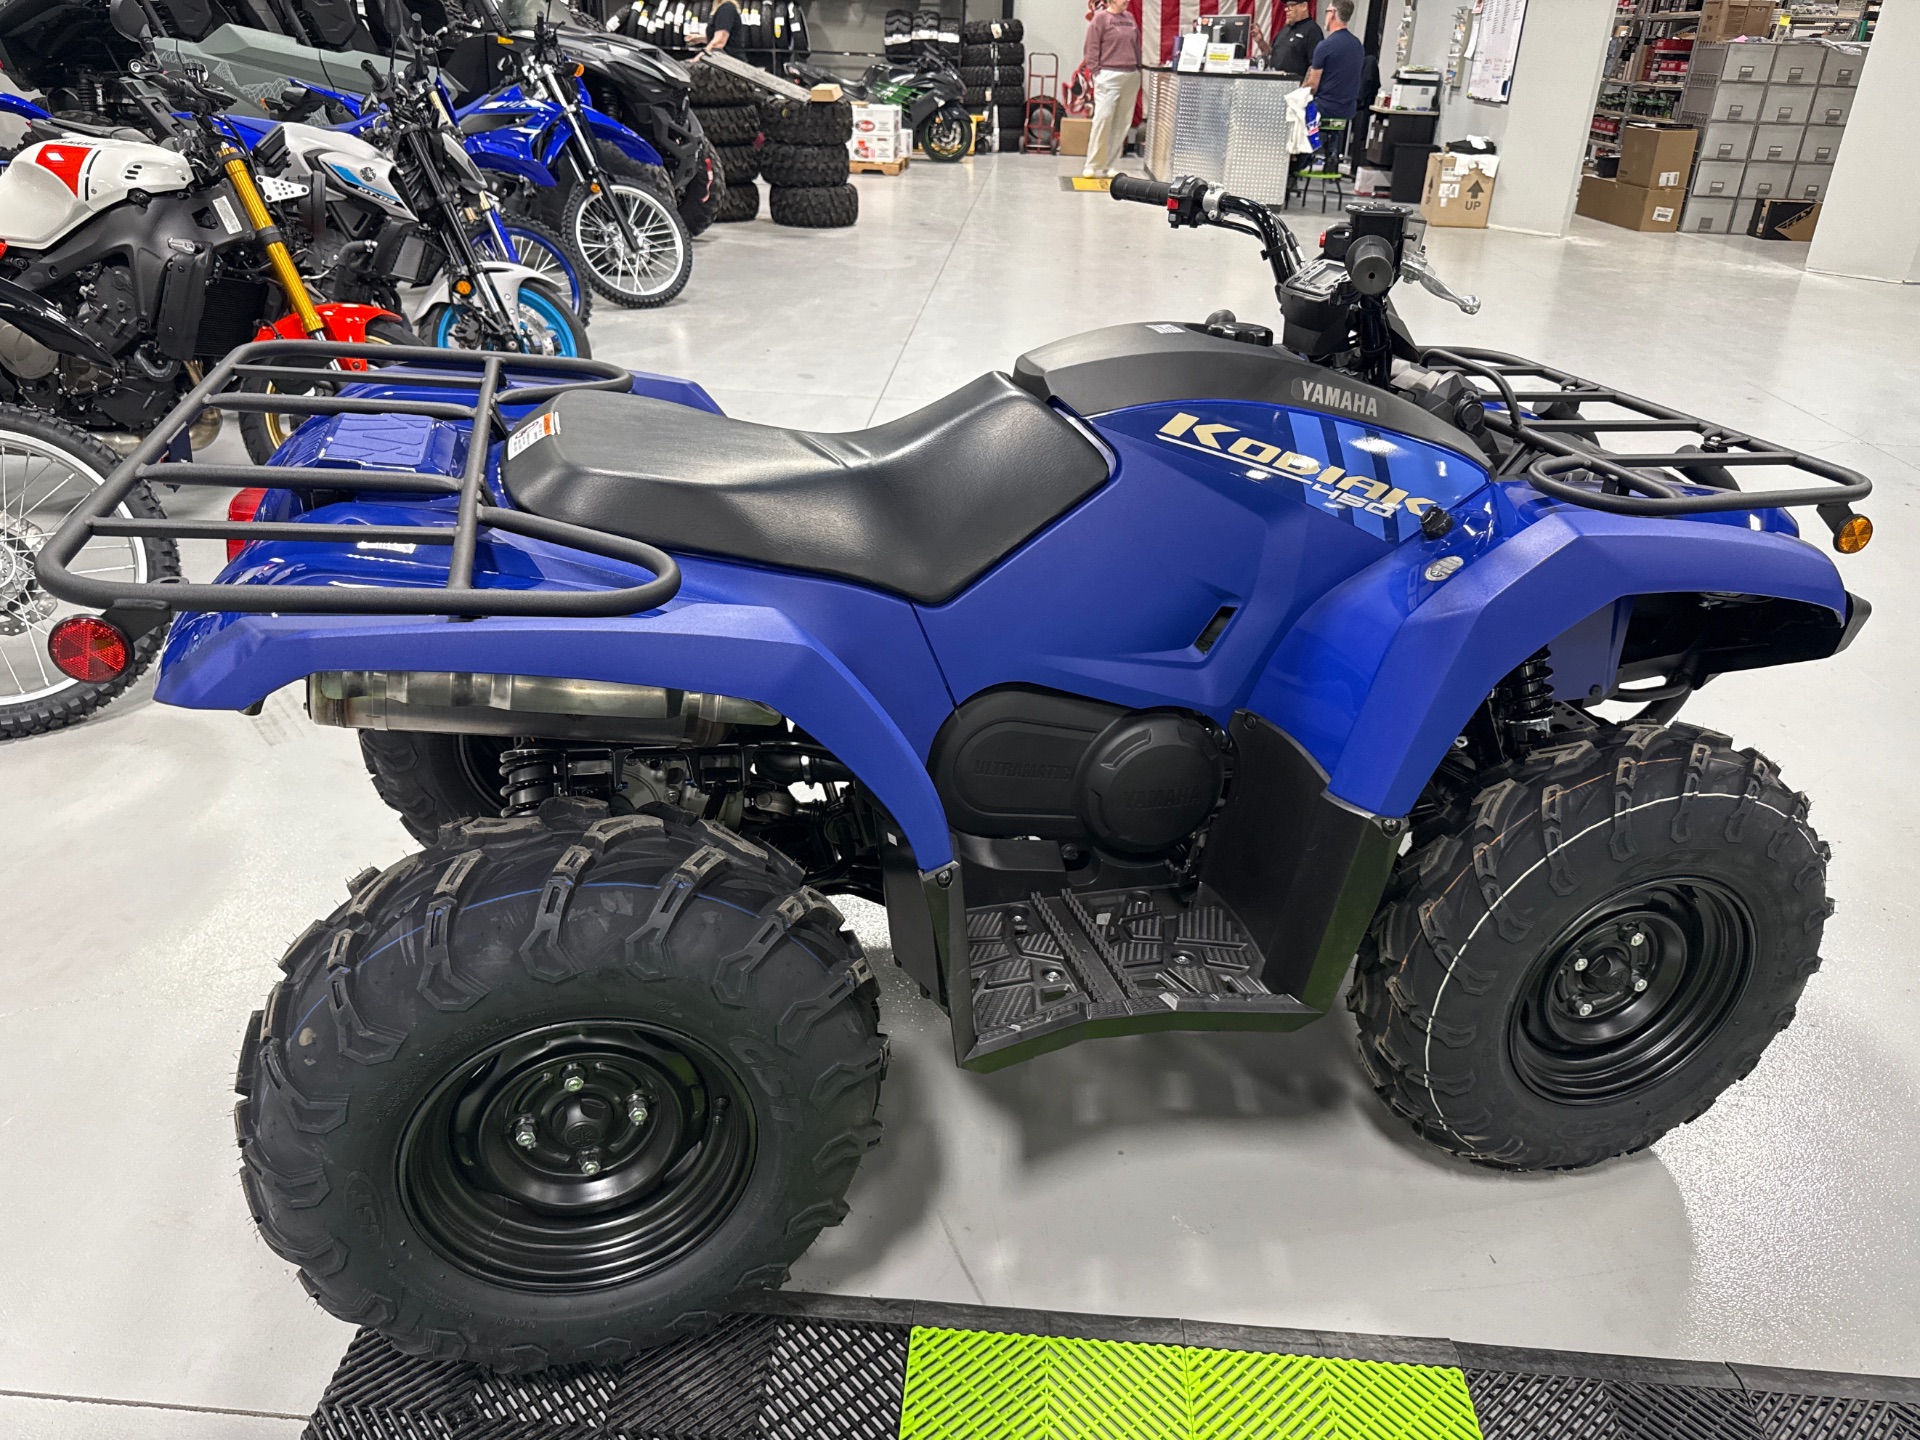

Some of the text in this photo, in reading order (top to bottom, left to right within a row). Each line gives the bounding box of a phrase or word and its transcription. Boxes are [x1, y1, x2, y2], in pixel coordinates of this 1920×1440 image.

[357, 186, 397, 205] MT-03
[1465, 201, 1481, 211] UP
[1301, 380, 1378, 418] YAMAHA
[1158, 411, 1438, 517] KODIAK
[1311, 483, 1395, 519] 450
[974, 759, 1075, 782] ULTRAMATIC
[1124, 786, 1201, 811] YAMAHA
[495, 1316, 537, 1330] NYLON
